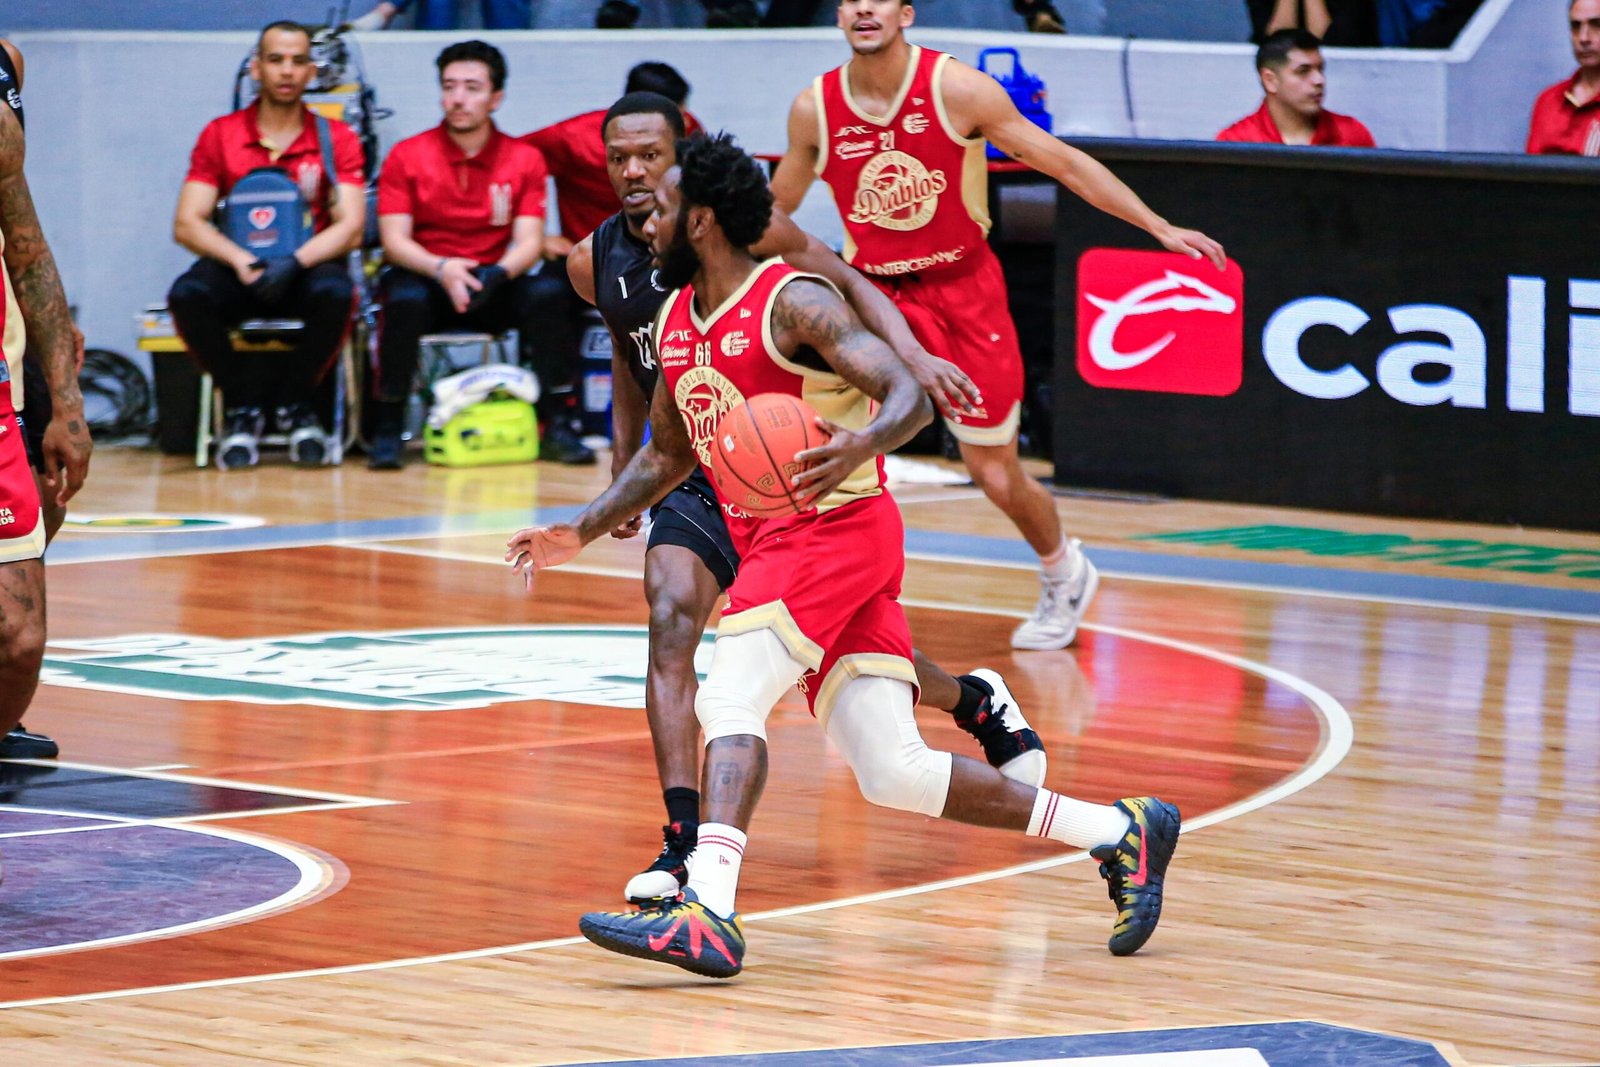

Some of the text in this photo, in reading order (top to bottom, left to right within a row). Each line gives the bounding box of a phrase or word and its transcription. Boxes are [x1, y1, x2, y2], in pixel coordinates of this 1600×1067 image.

[879, 131, 895, 150] 21
[848, 169, 947, 223] Diablos
[873, 249, 964, 275] INTERCERAMIC
[618, 276, 628, 299] 1
[695, 340, 711, 366] 66
[1262, 275, 1600, 416] cali
[676, 370, 739, 403] DIABLOS ROJOS
